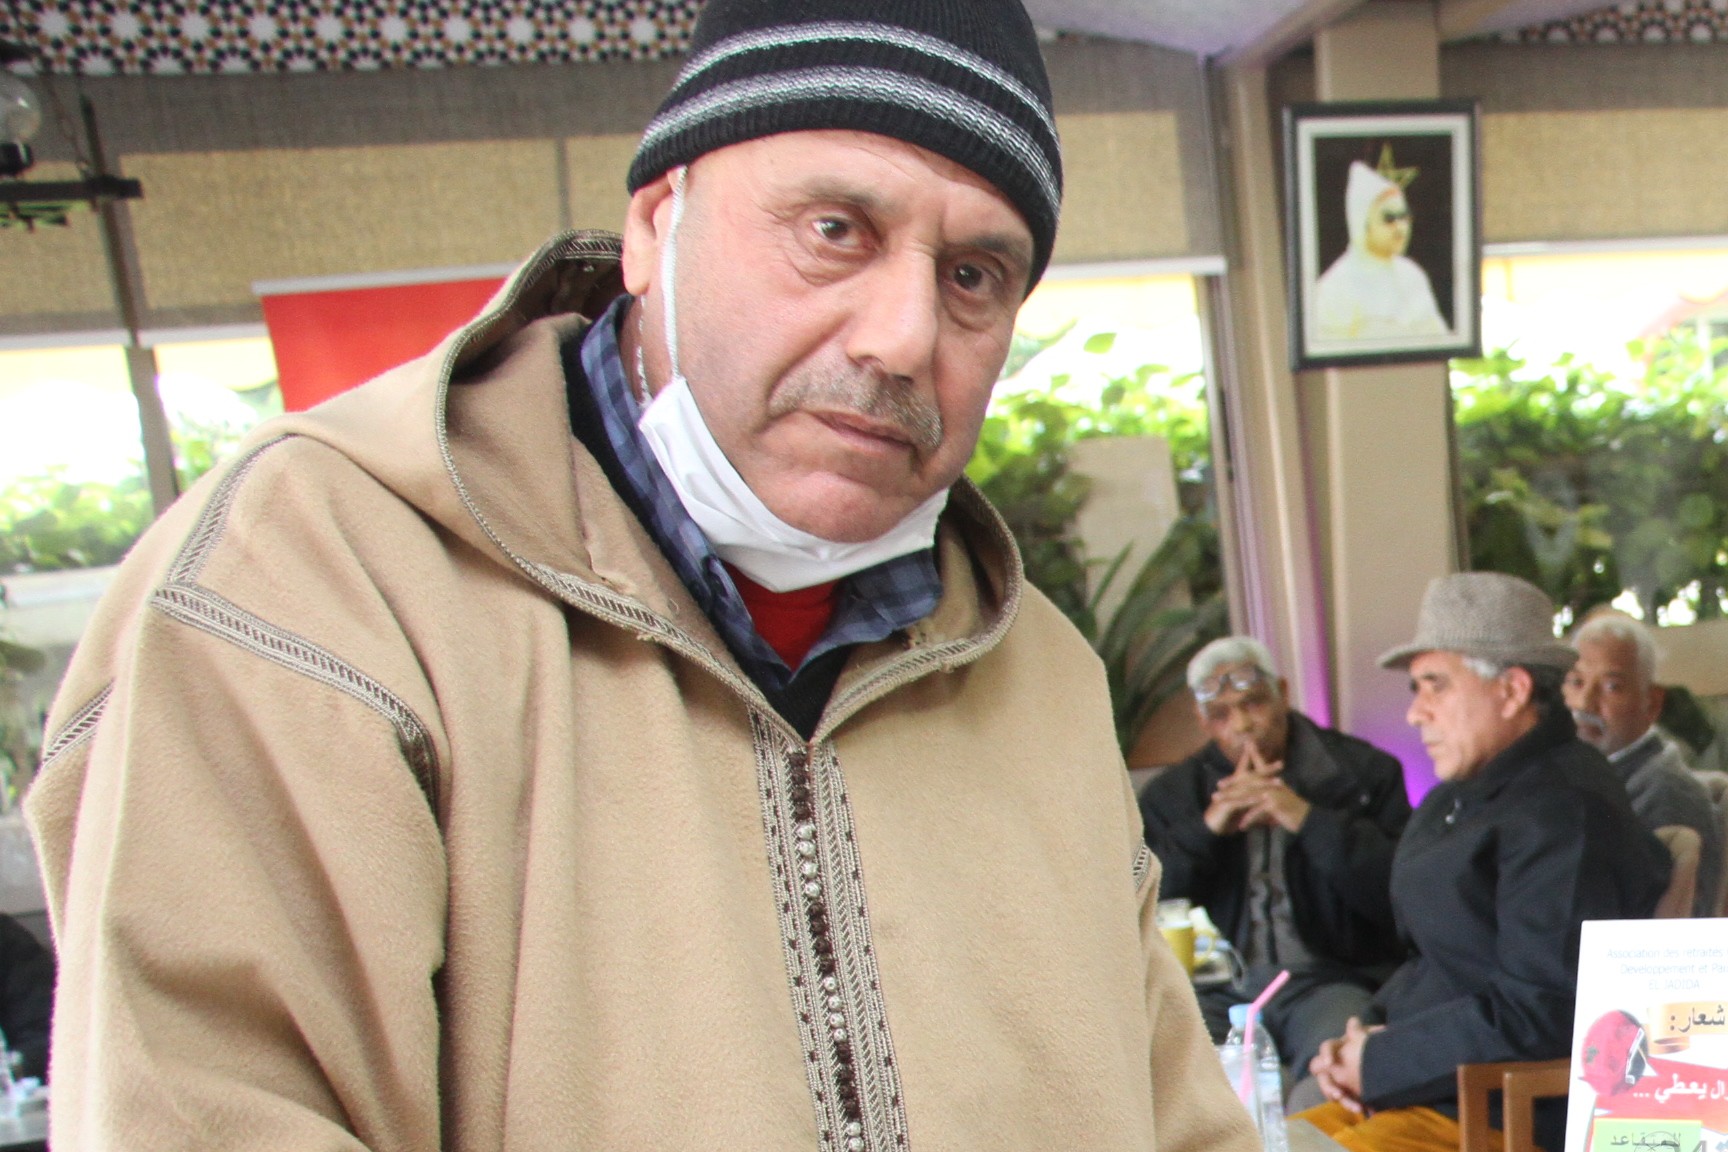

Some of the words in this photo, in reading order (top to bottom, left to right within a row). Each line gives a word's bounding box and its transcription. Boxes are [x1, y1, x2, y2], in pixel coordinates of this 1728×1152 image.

[1607, 947, 1660, 959] Association
[1663, 948, 1680, 958] des
[1698, 964, 1708, 974] et
[1654, 1073, 1708, 1103] يعطي
